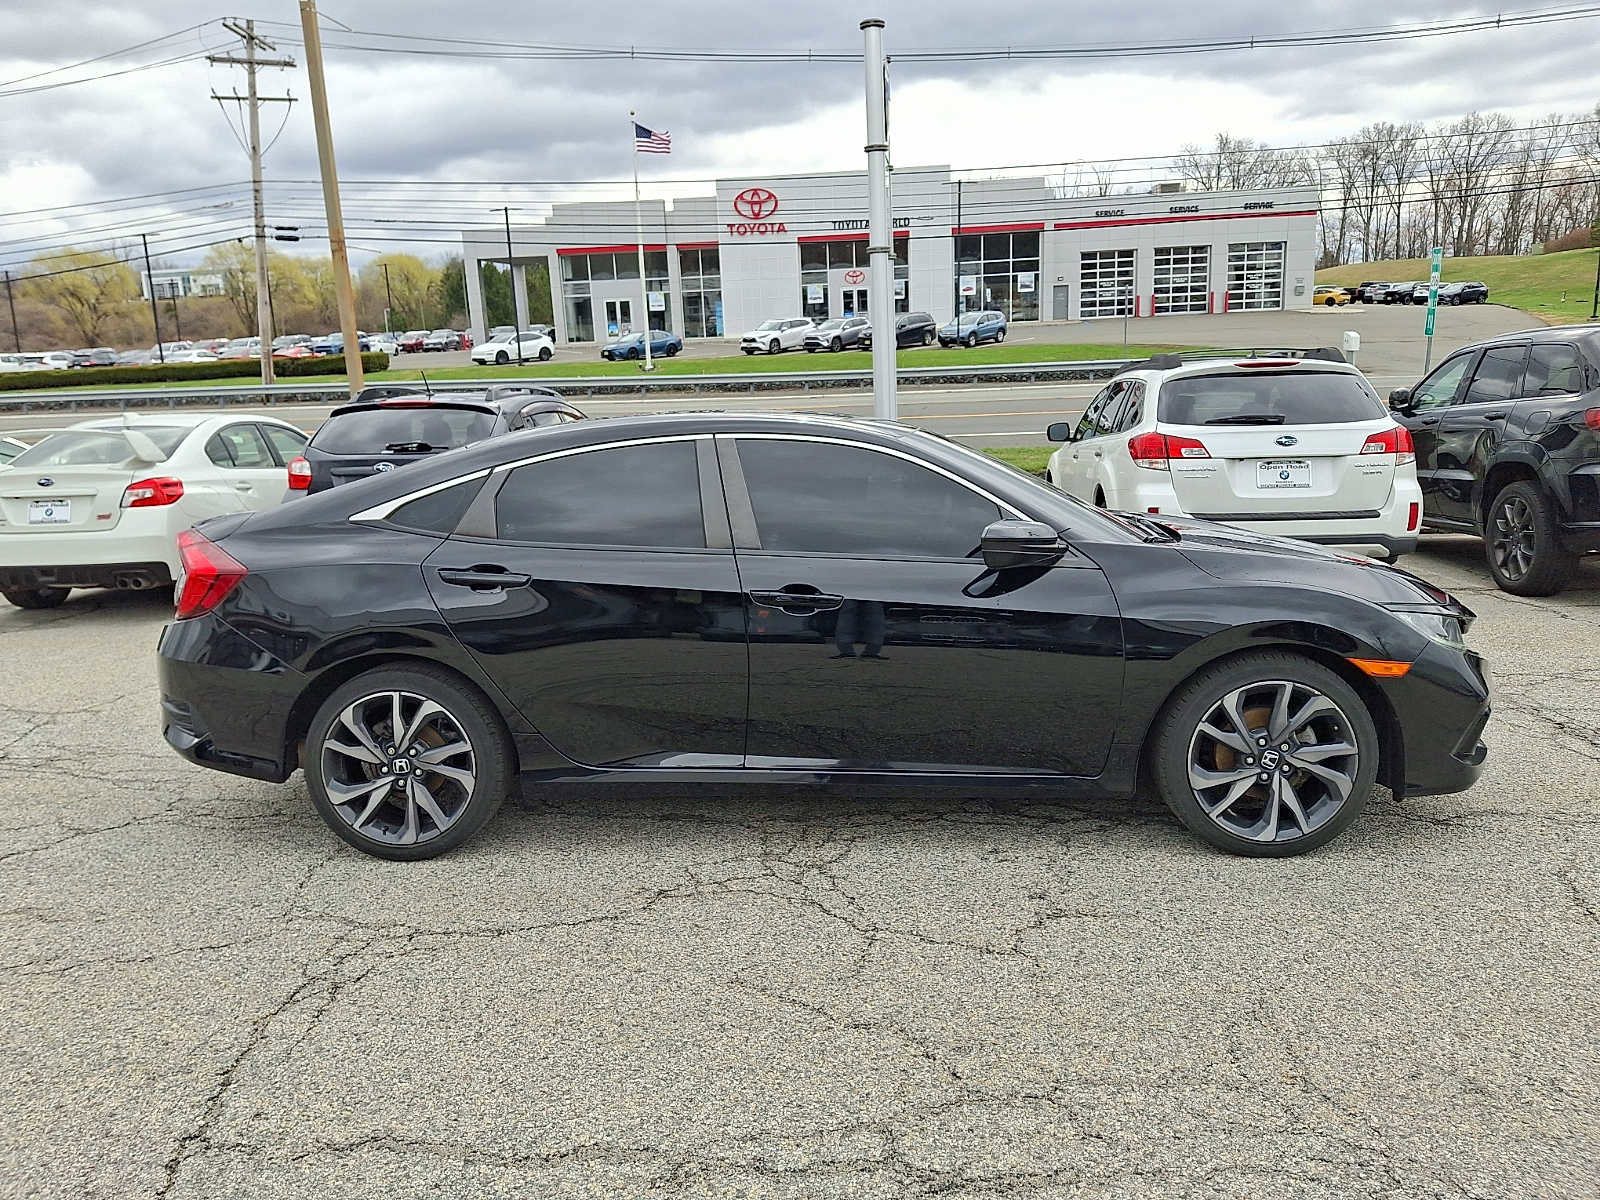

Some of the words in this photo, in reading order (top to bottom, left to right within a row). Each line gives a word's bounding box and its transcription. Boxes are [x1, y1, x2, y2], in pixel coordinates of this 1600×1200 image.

[1169, 205, 1200, 214] SERVICE
[1243, 202, 1274, 210] SERVICE
[1095, 209, 1126, 218] SERVICE
[727, 222, 788, 236] TOYOTA
[832, 219, 870, 231] TOYOTA
